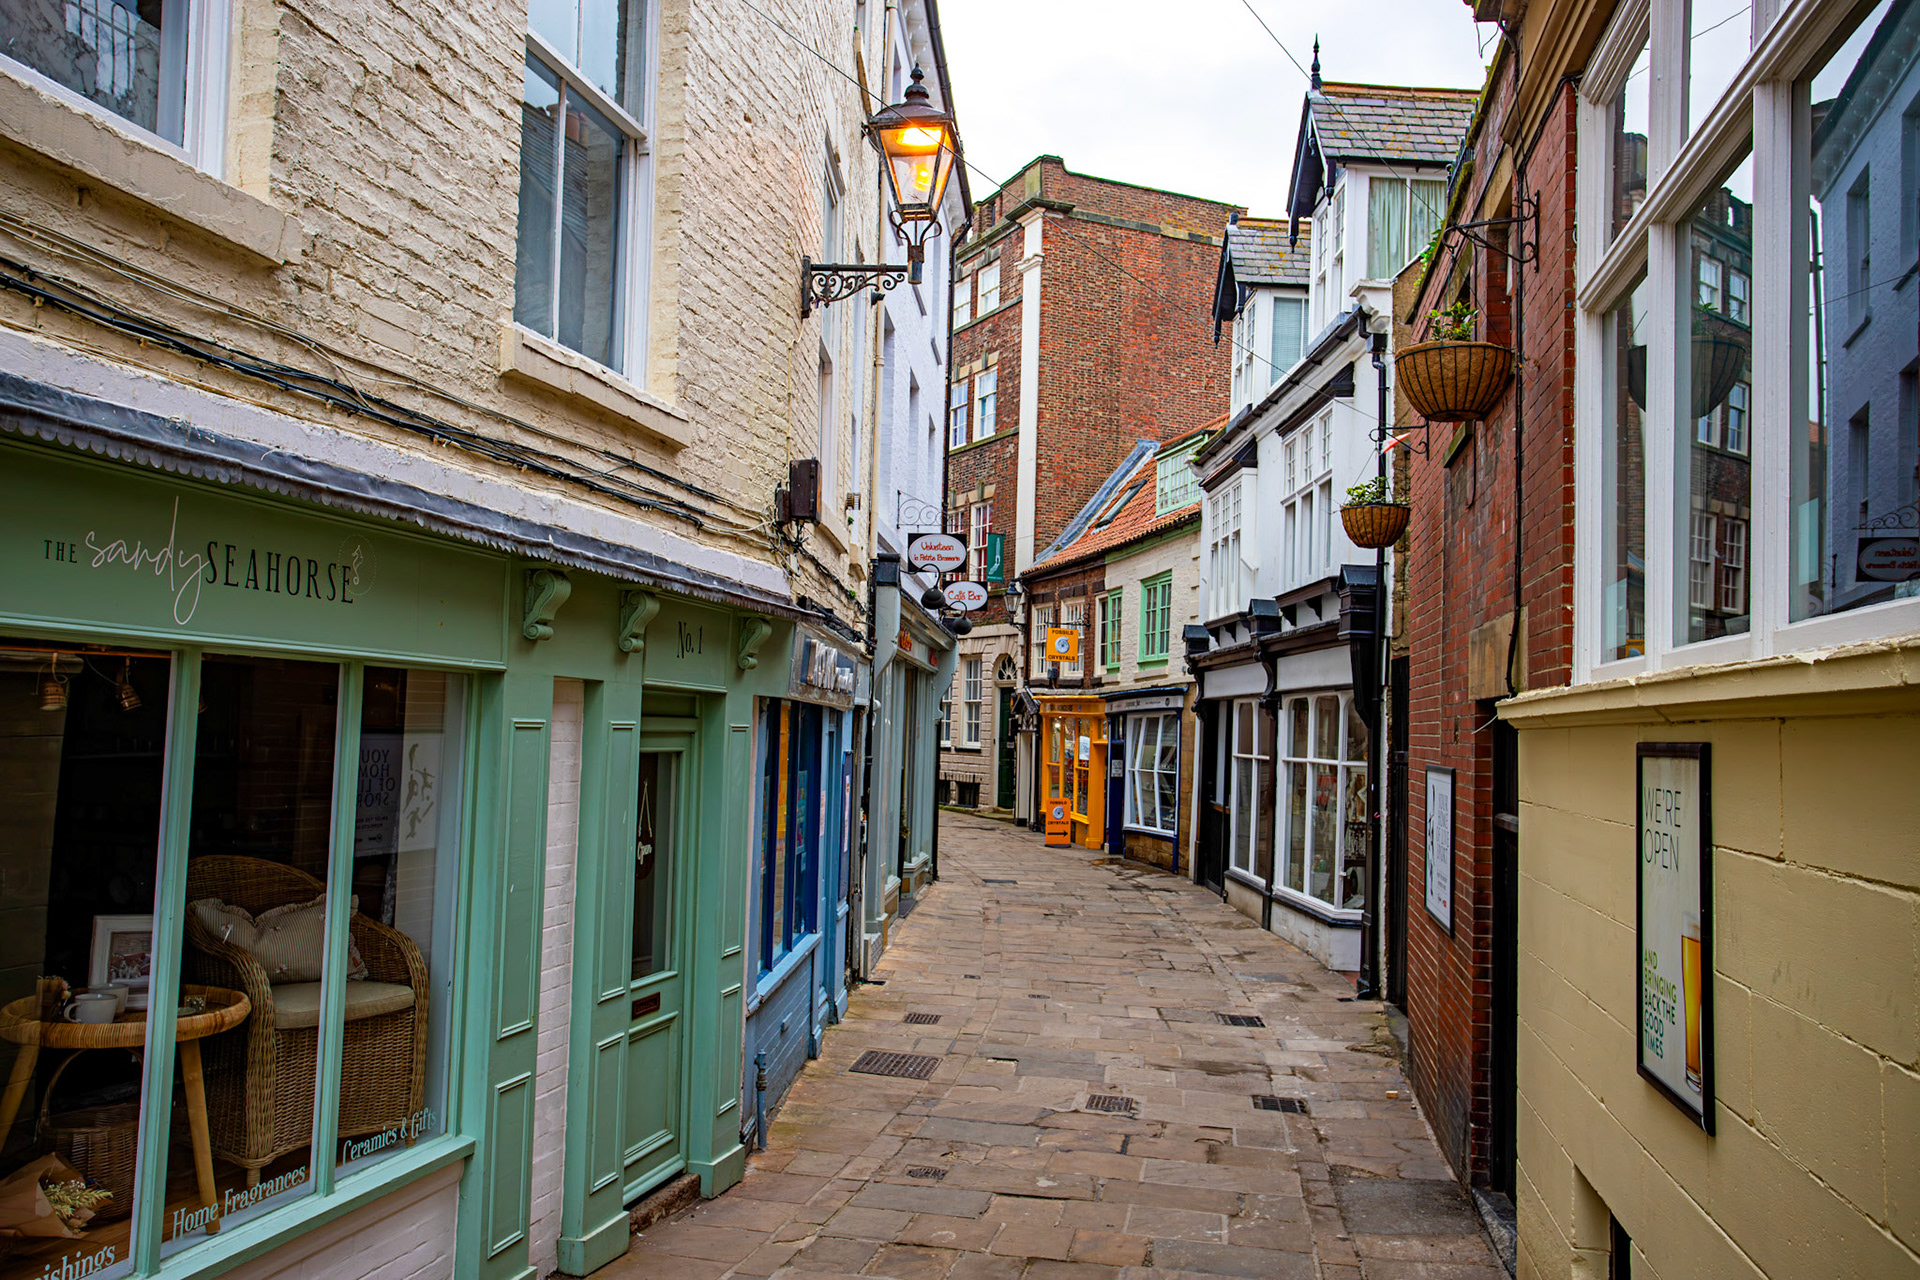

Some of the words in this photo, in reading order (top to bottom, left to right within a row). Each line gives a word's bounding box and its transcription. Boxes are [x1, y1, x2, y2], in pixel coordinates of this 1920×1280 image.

[43, 539, 78, 564] THE
[85, 496, 210, 625] sandy
[205, 541, 354, 604] SEAHORSE
[967, 590, 983, 601] Bar
[1643, 786, 1682, 828] WE'RE
[1643, 828, 1679, 873] OPEN
[1644, 947, 1658, 970] AND
[1644, 967, 1677, 1004] BRINGING
[1644, 987, 1662, 1015] BACK
[1661, 999, 1676, 1026] THE
[1644, 1008, 1665, 1038] GOOD
[1644, 1028, 1664, 1060] TIMES
[342, 1125, 398, 1165] Ceramics
[400, 1117, 408, 1139] &
[411, 1107, 437, 1139] Gifts
[172, 1203, 219, 1240] Home
[223, 1165, 306, 1218] Fragrances
[34, 1245, 116, 1280] ishings
